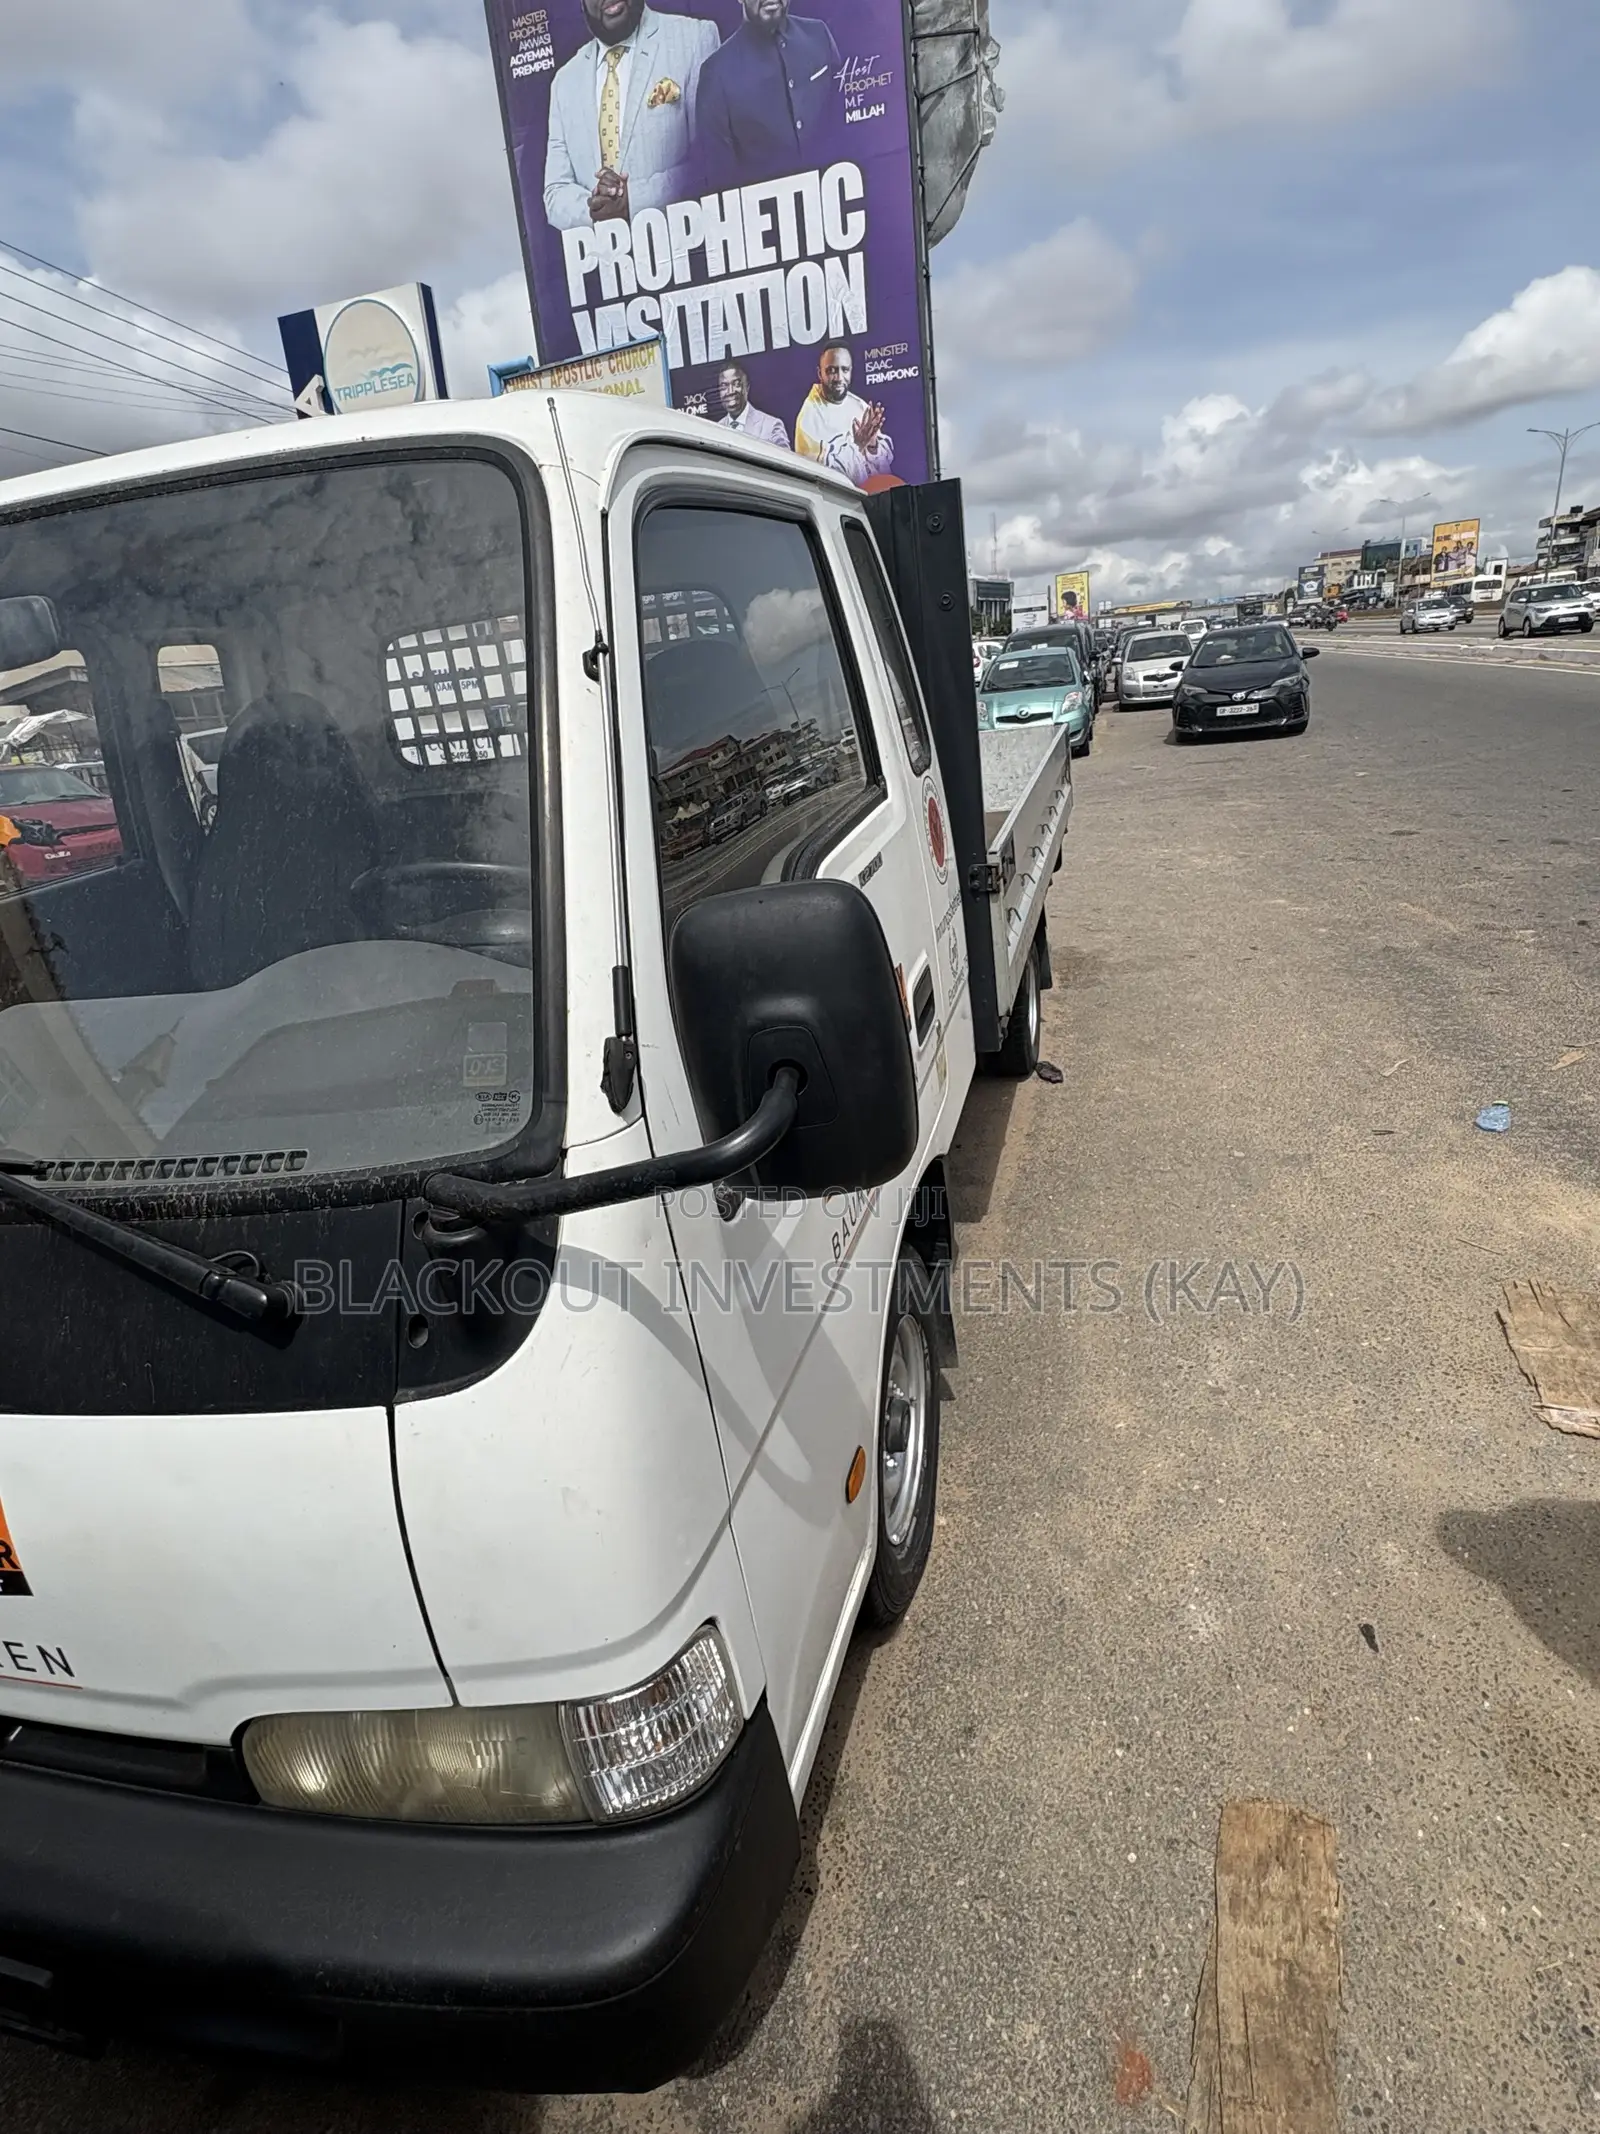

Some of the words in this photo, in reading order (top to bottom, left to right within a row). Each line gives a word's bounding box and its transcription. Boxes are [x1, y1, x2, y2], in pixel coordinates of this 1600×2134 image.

[512, 9, 548, 29] MASTER
[509, 20, 550, 42] PROPHET
[519, 33, 552, 53] AKWASI
[510, 45, 554, 68] AGYEMAN
[512, 57, 555, 79] PREMPEH
[833, 54, 880, 92] Host
[844, 71, 893, 95] PROPHET
[845, 102, 885, 124] MILLAH
[561, 161, 866, 308] PROPHETIC
[608, 345, 656, 374] CHURCH
[864, 342, 908, 361] MINISTER
[865, 358, 893, 373] ISAAC
[866, 365, 919, 386] FRIMPONG
[335, 372, 417, 401] TRIPPLESEA
[684, 391, 708, 406] JACK
